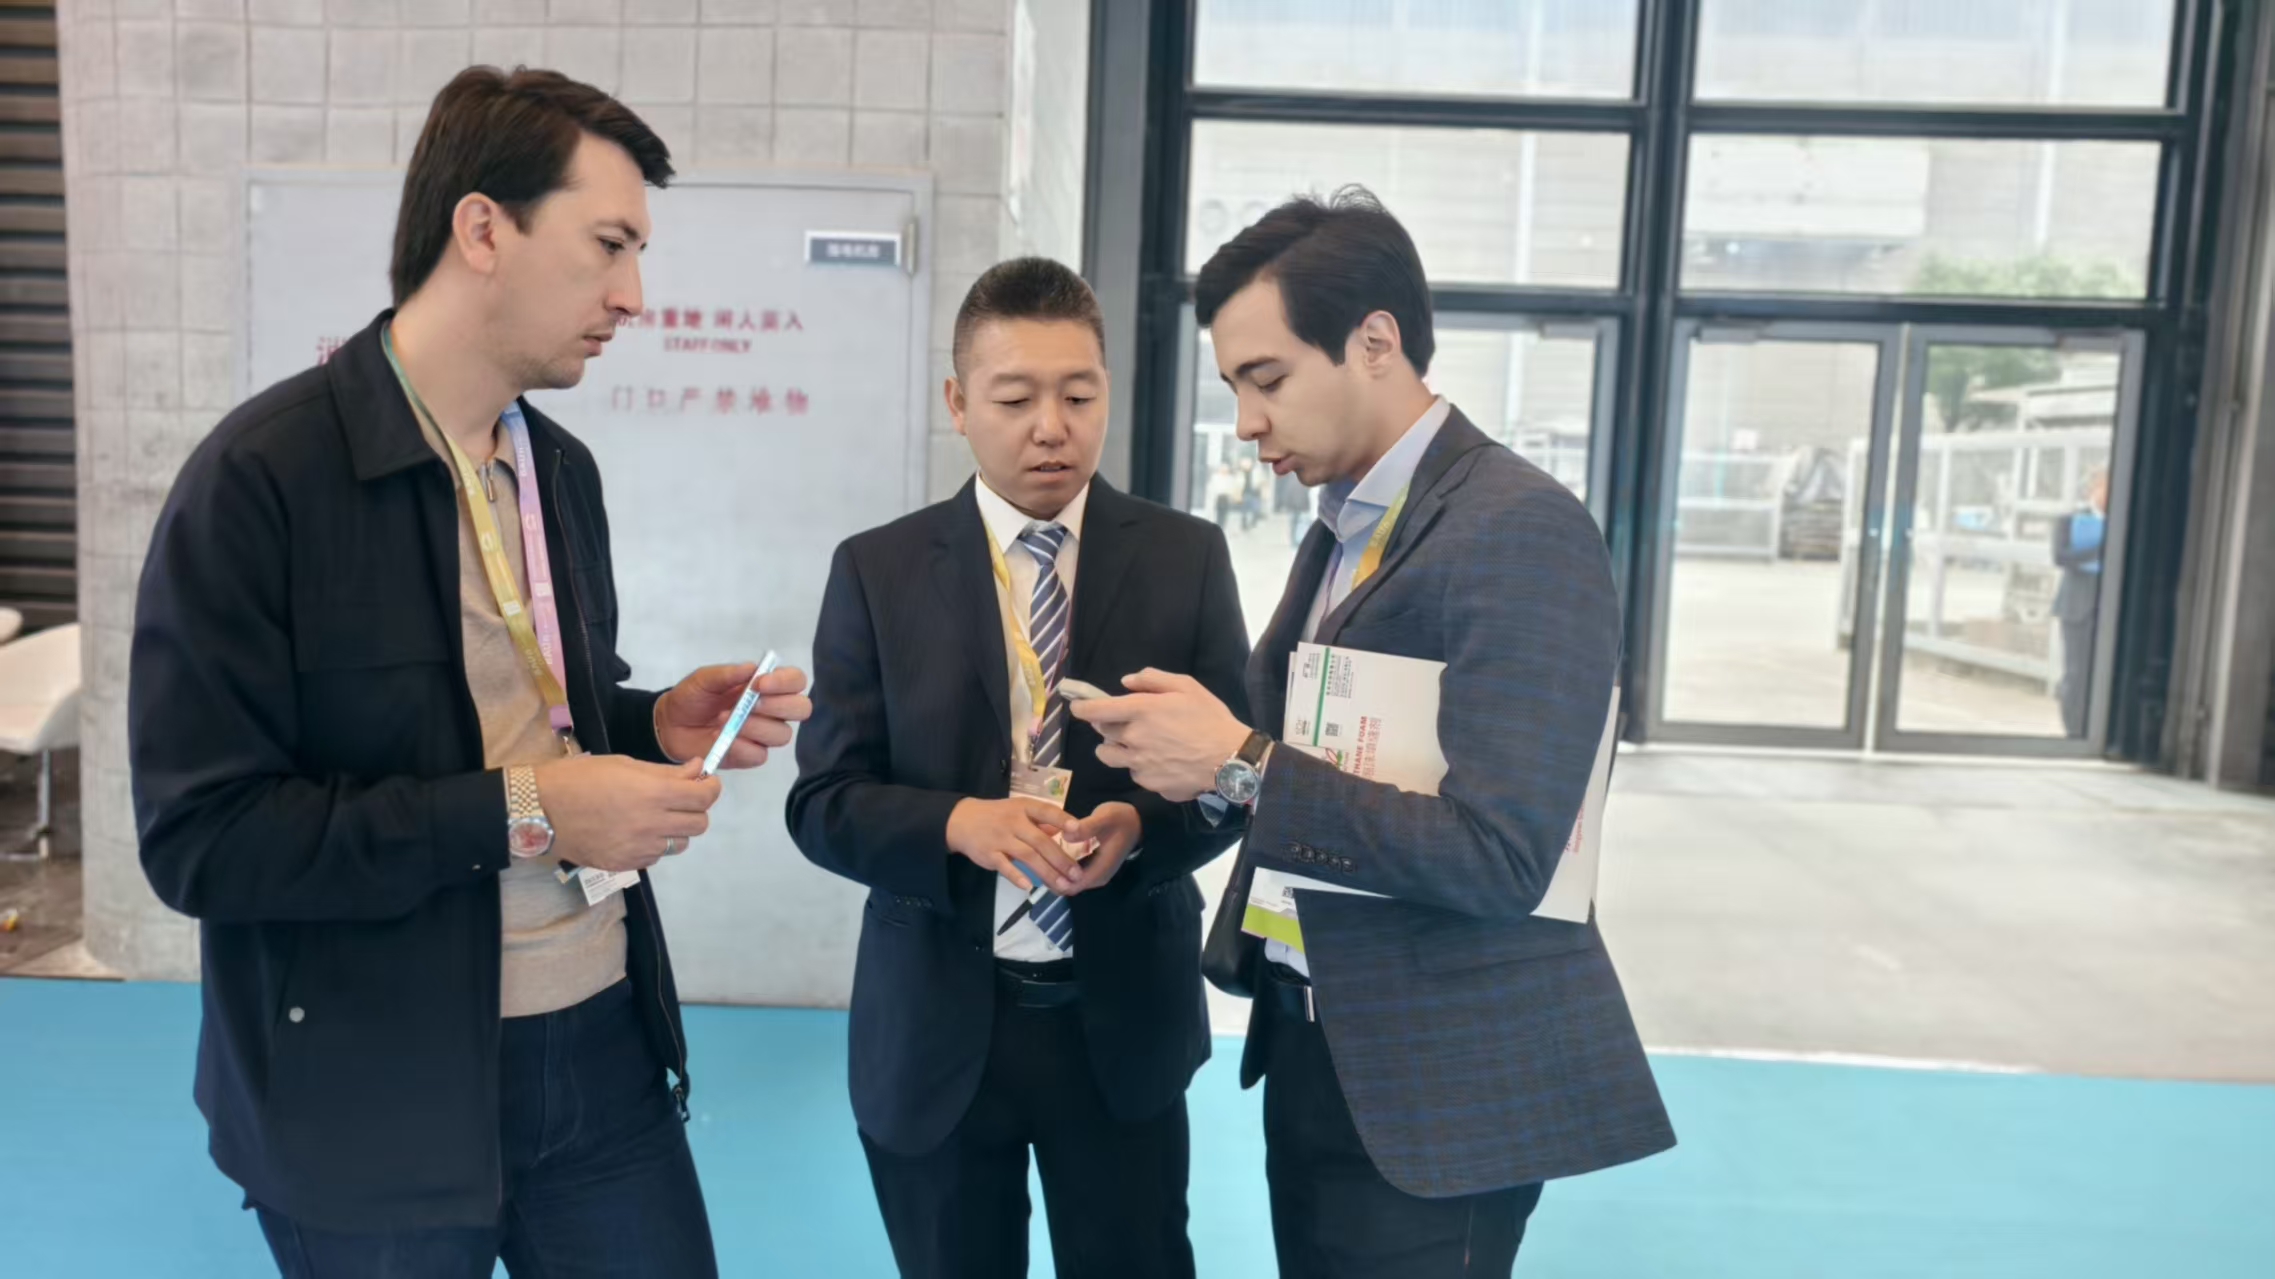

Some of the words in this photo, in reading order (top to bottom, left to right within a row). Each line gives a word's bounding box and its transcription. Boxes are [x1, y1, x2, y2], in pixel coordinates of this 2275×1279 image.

[663, 336, 710, 353] STAFF
[711, 338, 752, 354] ONLY
[1357, 715, 1368, 742] FOAM
